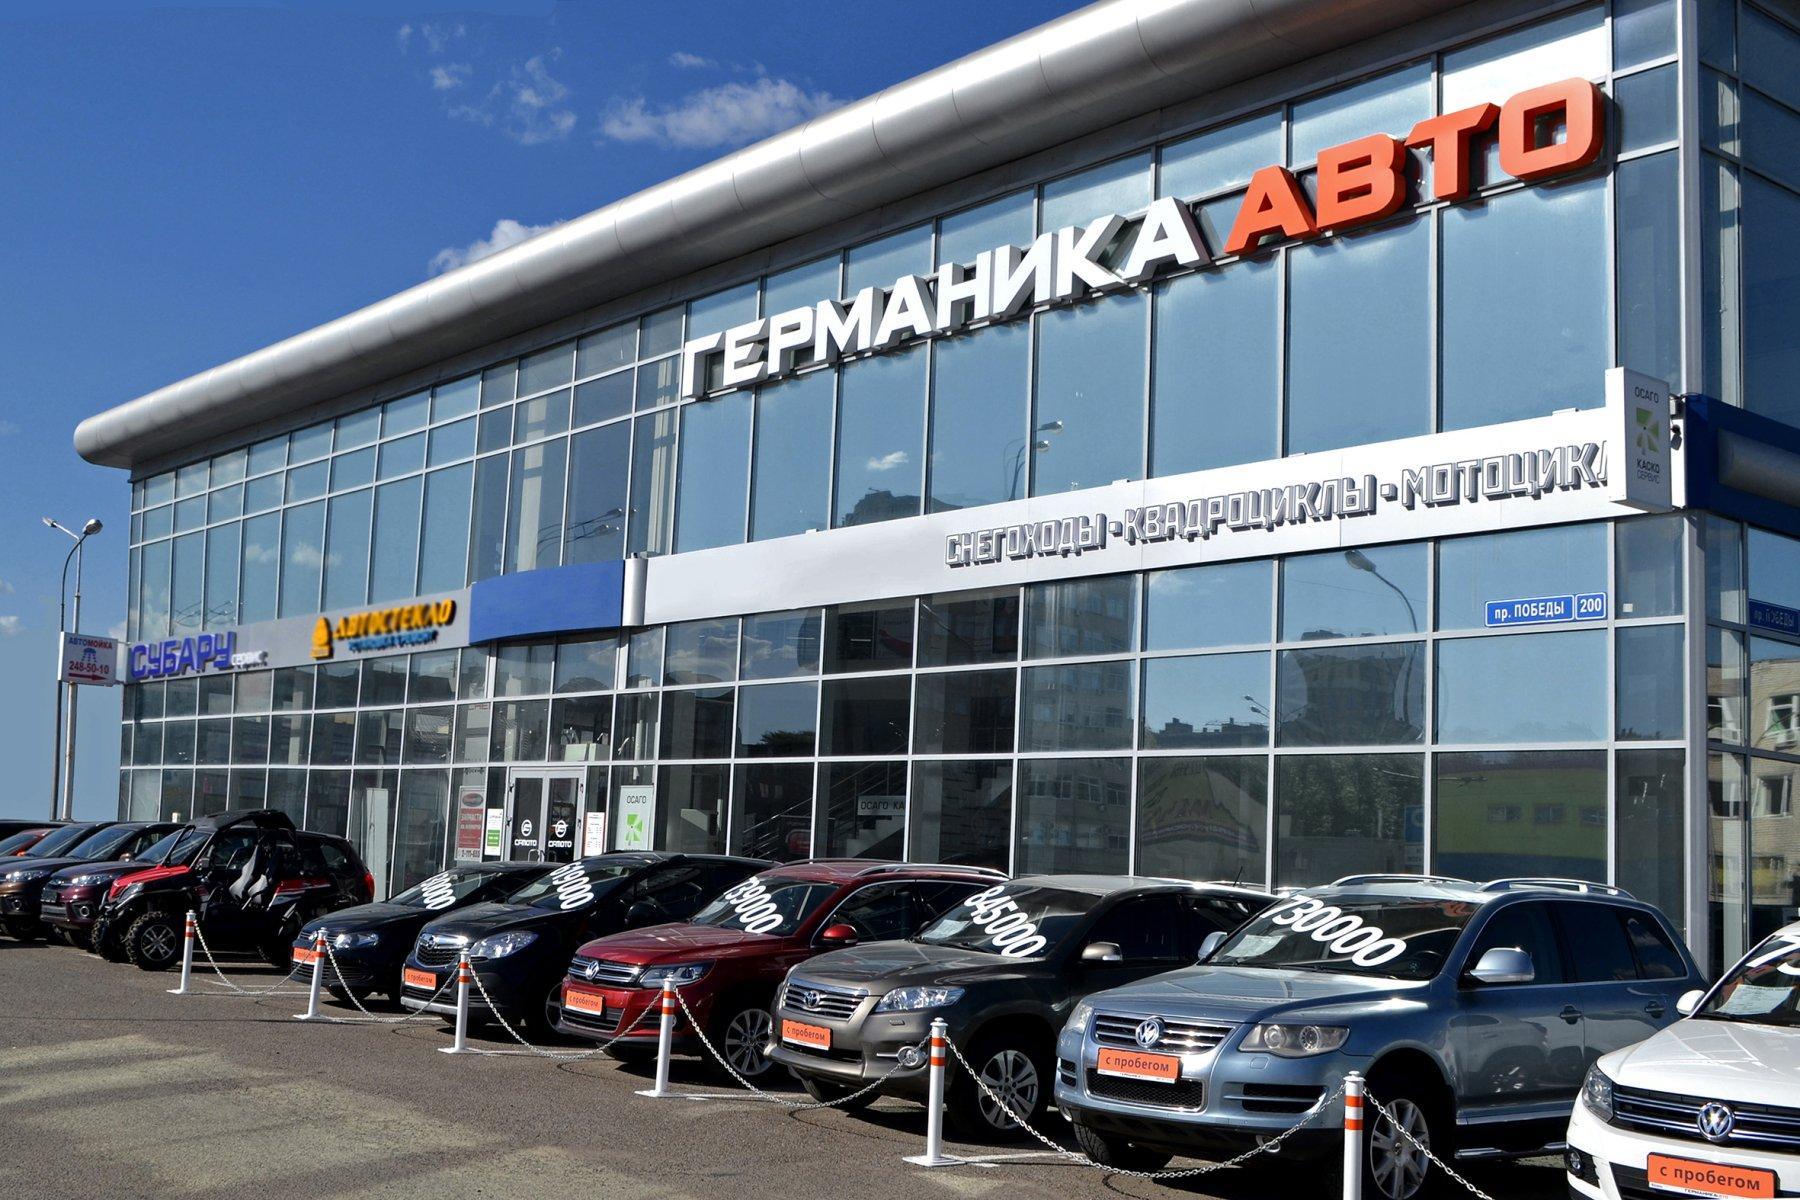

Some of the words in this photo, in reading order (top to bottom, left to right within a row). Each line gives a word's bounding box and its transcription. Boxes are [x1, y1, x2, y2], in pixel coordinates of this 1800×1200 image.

[682, 197, 1209, 399] ГЕРМАНИКА
[1223, 76, 1603, 254] АВТО
[1634, 386, 1659, 404] ОСАГО
[1636, 458, 1660, 474] КАСКО
[945, 512, 1106, 566] СНЕГОХОДЫ
[1123, 473, 1376, 542] КВАДРОЦИКЛЫ
[1494, 608, 1511, 622] пр.
[1514, 601, 1564, 618] ПОБЕДЫ
[1580, 597, 1602, 613] 200
[68, 636, 113, 649] АВТОМОЙКА
[131, 631, 236, 679] СУБАРУ
[69, 661, 110, 674] 248-50-10
[626, 795, 647, 804] ОСАГО
[860, 801, 889, 810] ОСАГО
[549, 861, 594, 910] 619000
[723, 876, 783, 934] 739000
[963, 885, 1047, 958] 845000
[1259, 894, 1407, 967] 730000
[792, 1027, 825, 1040] пробегом
[1106, 1057, 1110, 1065] с
[1114, 1057, 1169, 1072] пробегом
[1660, 1166, 1667, 1176] с
[1674, 1169, 1760, 1191] пробегом
